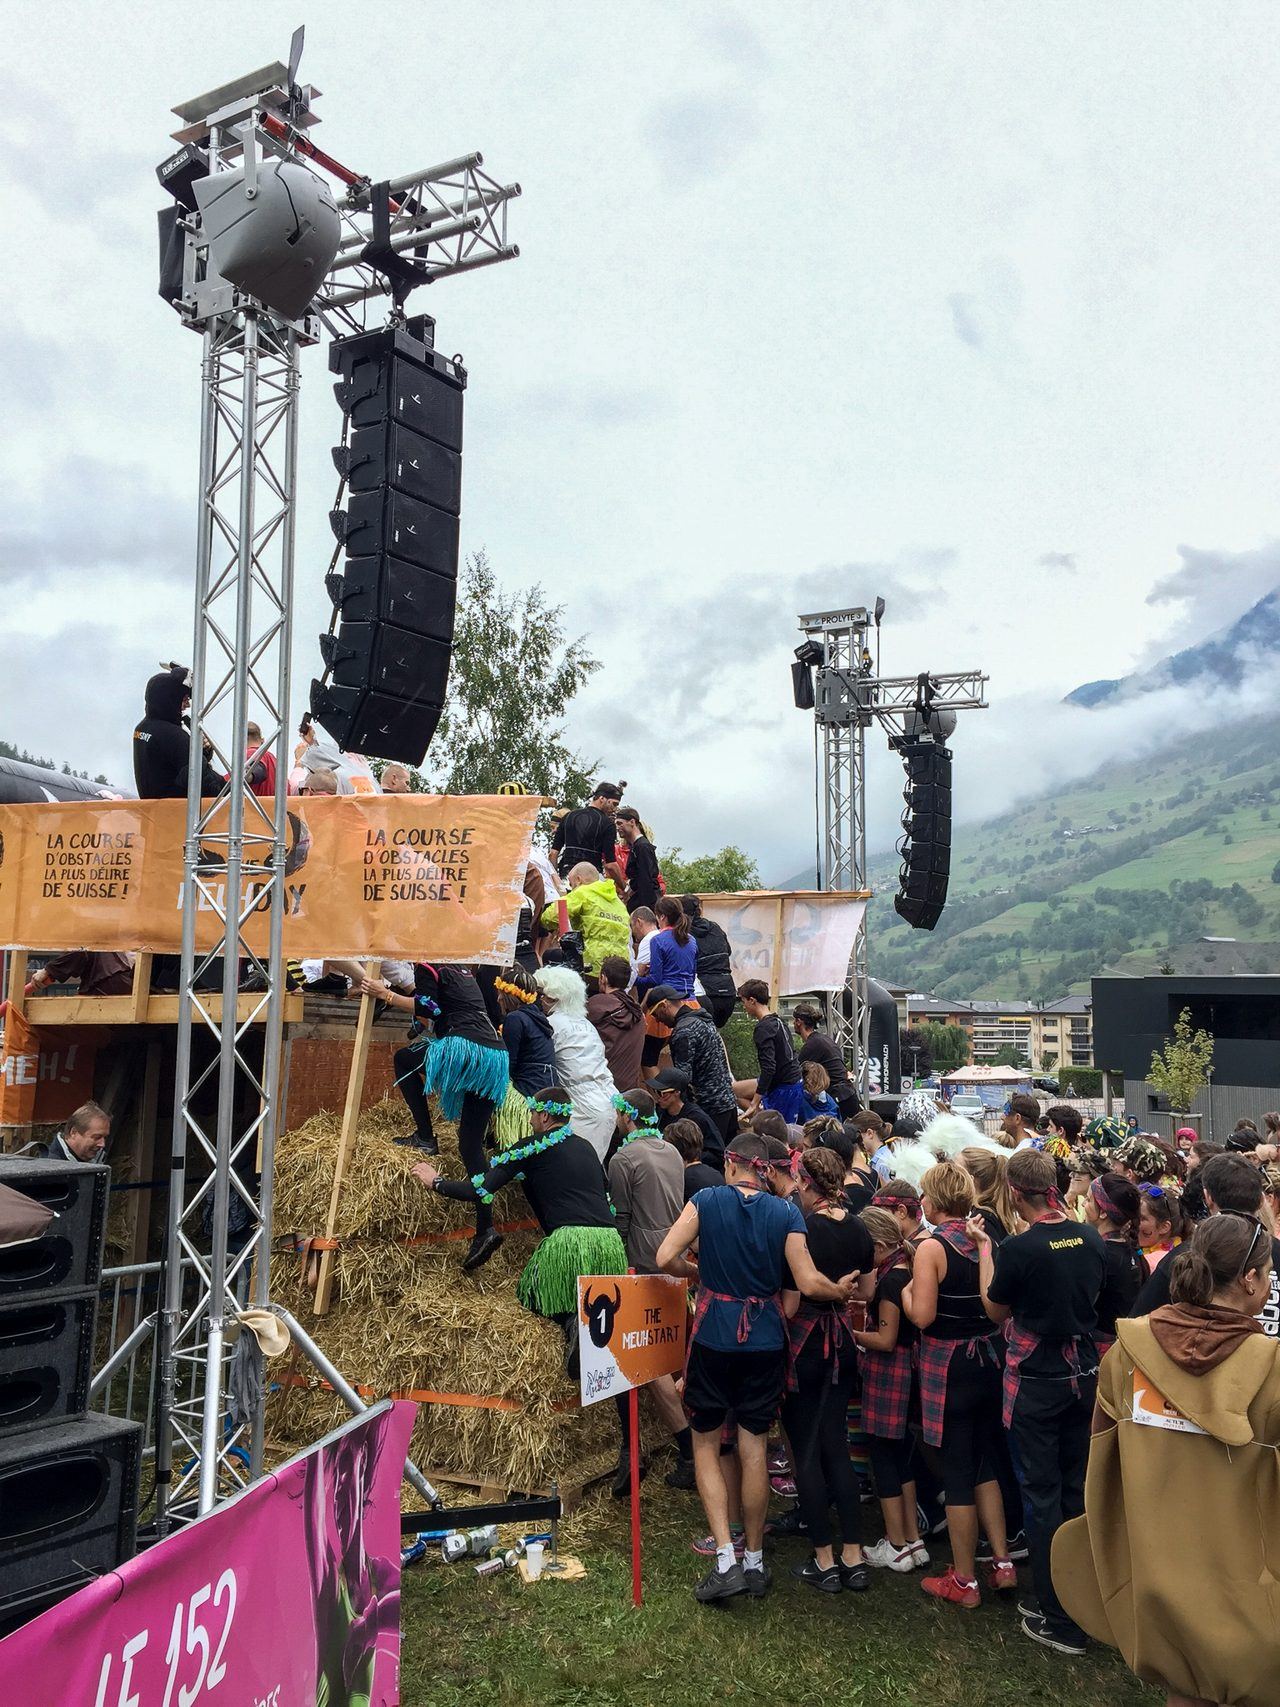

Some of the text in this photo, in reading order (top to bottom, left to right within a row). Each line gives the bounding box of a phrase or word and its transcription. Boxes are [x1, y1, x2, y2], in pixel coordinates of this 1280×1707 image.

[821, 613, 855, 625] PROLYTE
[47, 832, 135, 849] LA COURSE
[366, 828, 476, 847] LA COURSE
[46, 852, 132, 866] D'OBSTACLES
[363, 849, 470, 865] D'OBSTACLES
[44, 869, 57, 880] LA
[61, 869, 86, 880] PLUS
[364, 865, 469, 881] LA PLUS DÉLIRE
[42, 882, 63, 898] DE
[67, 882, 118, 898] SUISSE
[363, 884, 386, 901] DE
[390, 883, 452, 901] SUISSE
[1049, 1237, 1084, 1250] tonique
[597, 1308, 606, 1334] 1
[645, 1308, 661, 1325] THE
[622, 1325, 680, 1350] MEUHSTART
[162, 1568, 237, 1707] 152
